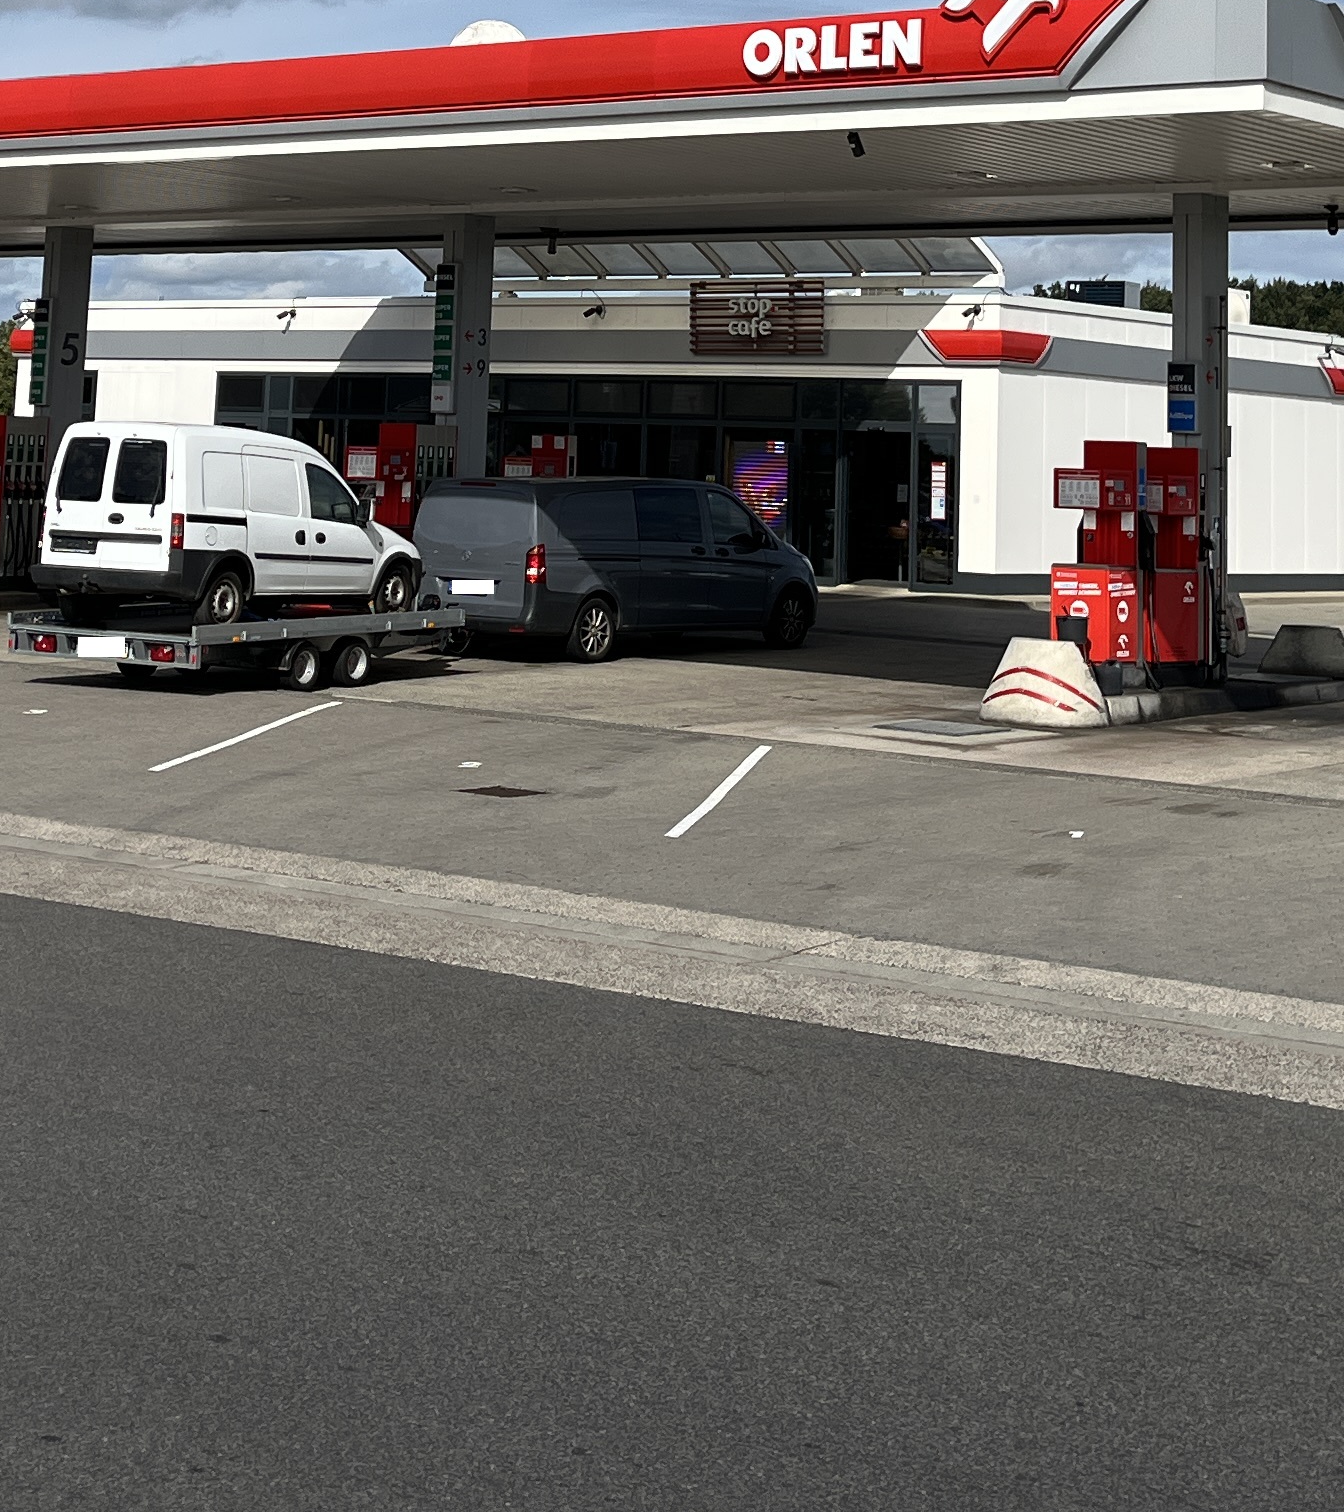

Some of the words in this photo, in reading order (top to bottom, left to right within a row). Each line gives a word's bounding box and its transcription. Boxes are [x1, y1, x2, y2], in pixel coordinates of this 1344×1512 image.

[742, 17, 923, 78] ORLEN
[477, 328, 487, 347] 3
[728, 317, 772, 338] cafe
[60, 332, 80, 366] 5
[476, 358, 486, 378] 9
